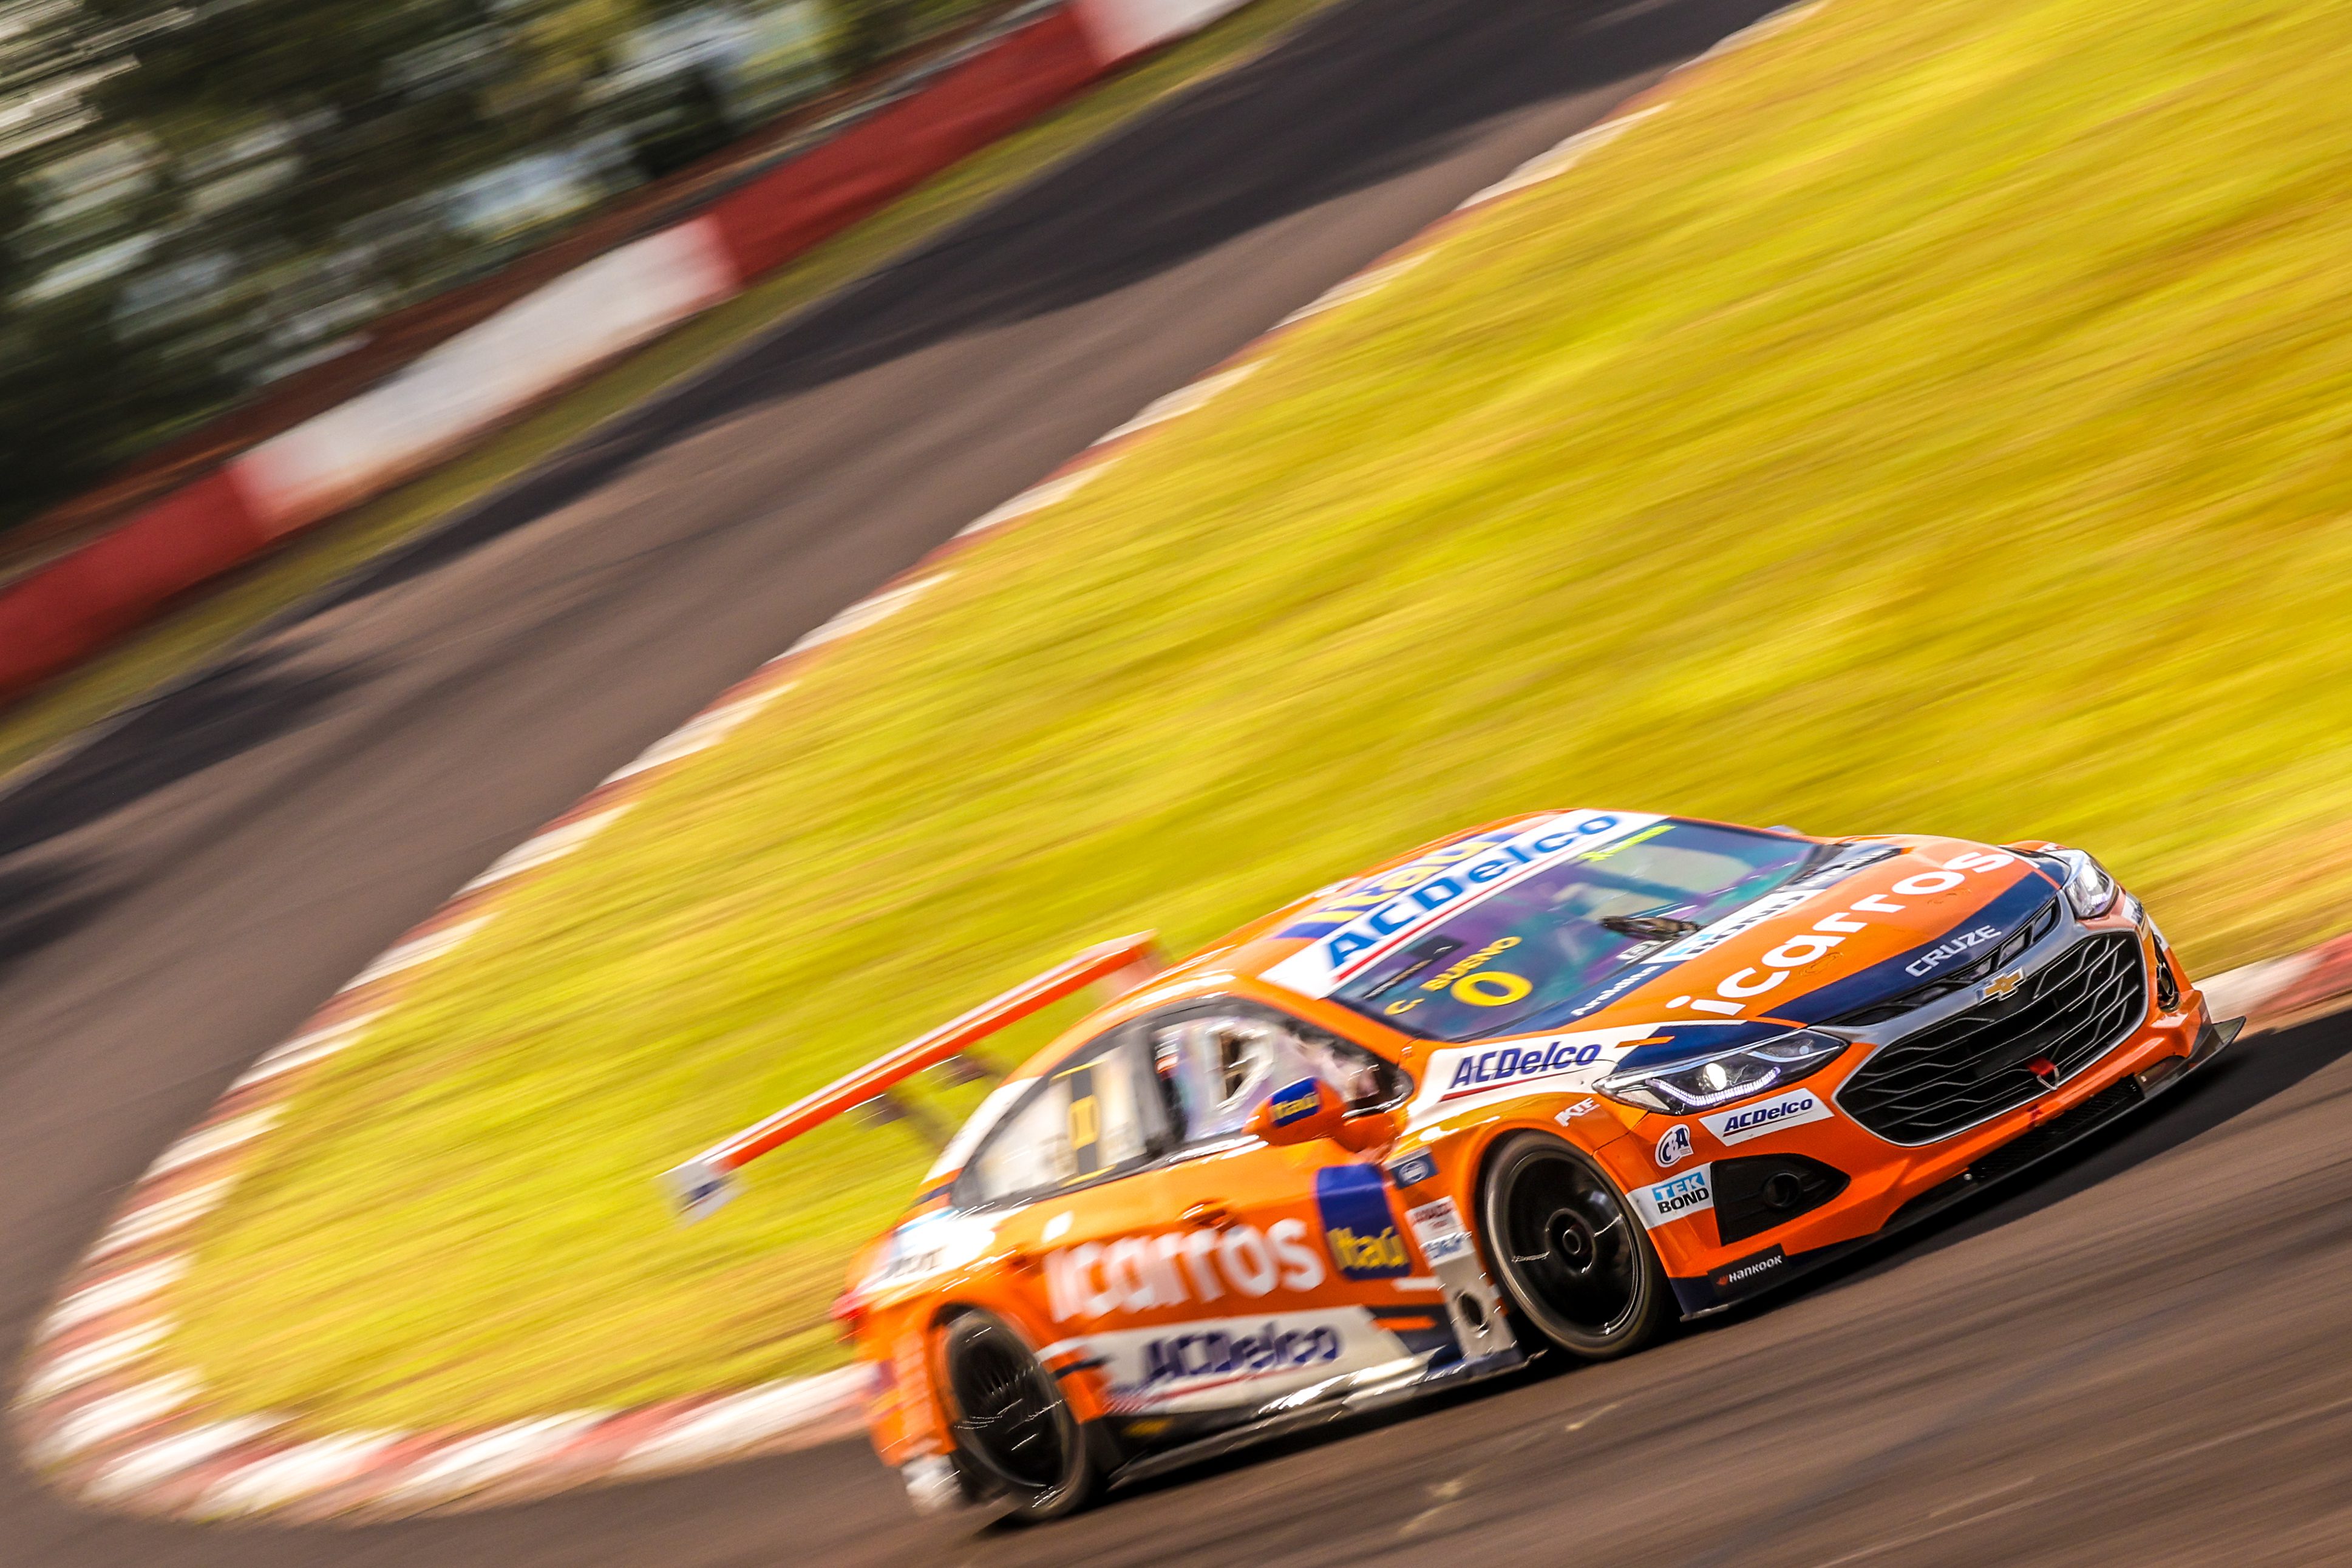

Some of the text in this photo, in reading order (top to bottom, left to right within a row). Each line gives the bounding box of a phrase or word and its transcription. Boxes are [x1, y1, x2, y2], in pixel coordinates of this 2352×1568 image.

[1326, 815, 1620, 968] ACDelco
[1666, 851, 2017, 1016] icarros
[1905, 925, 2003, 977] CRUZE
[1419, 936, 1523, 991] BUENO
[1448, 1041, 1602, 1090] ACDelco
[1722, 1098, 1813, 1132] ACDelco
[1662, 1127, 1689, 1162] CBA
[1656, 1174, 1701, 1199] TEK
[1657, 1187, 1709, 1214] BOND
